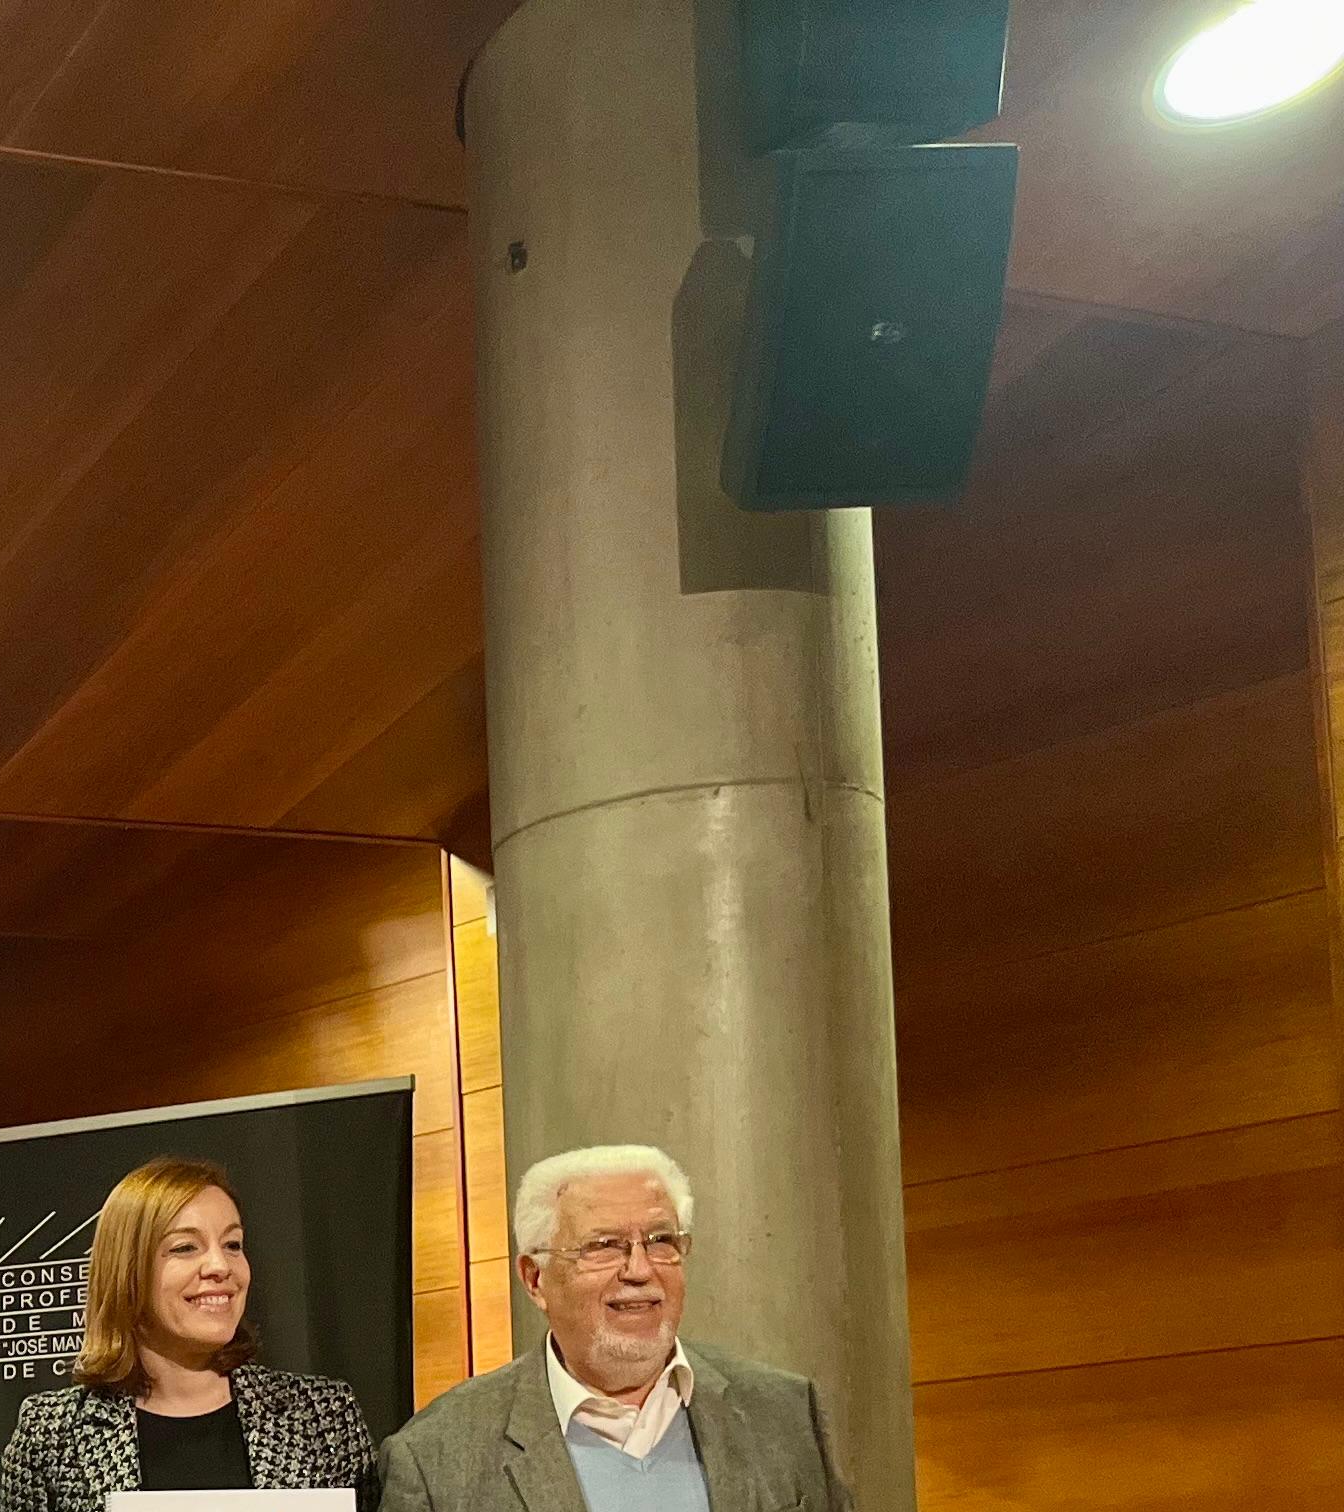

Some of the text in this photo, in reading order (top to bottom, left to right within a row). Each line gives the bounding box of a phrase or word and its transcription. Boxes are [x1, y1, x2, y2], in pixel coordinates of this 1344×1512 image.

[2, 1264, 90, 1287] CONSE
[2, 1288, 88, 1310] PROFE
[3, 1315, 41, 1333] DE
[3, 1362, 35, 1380] DE
